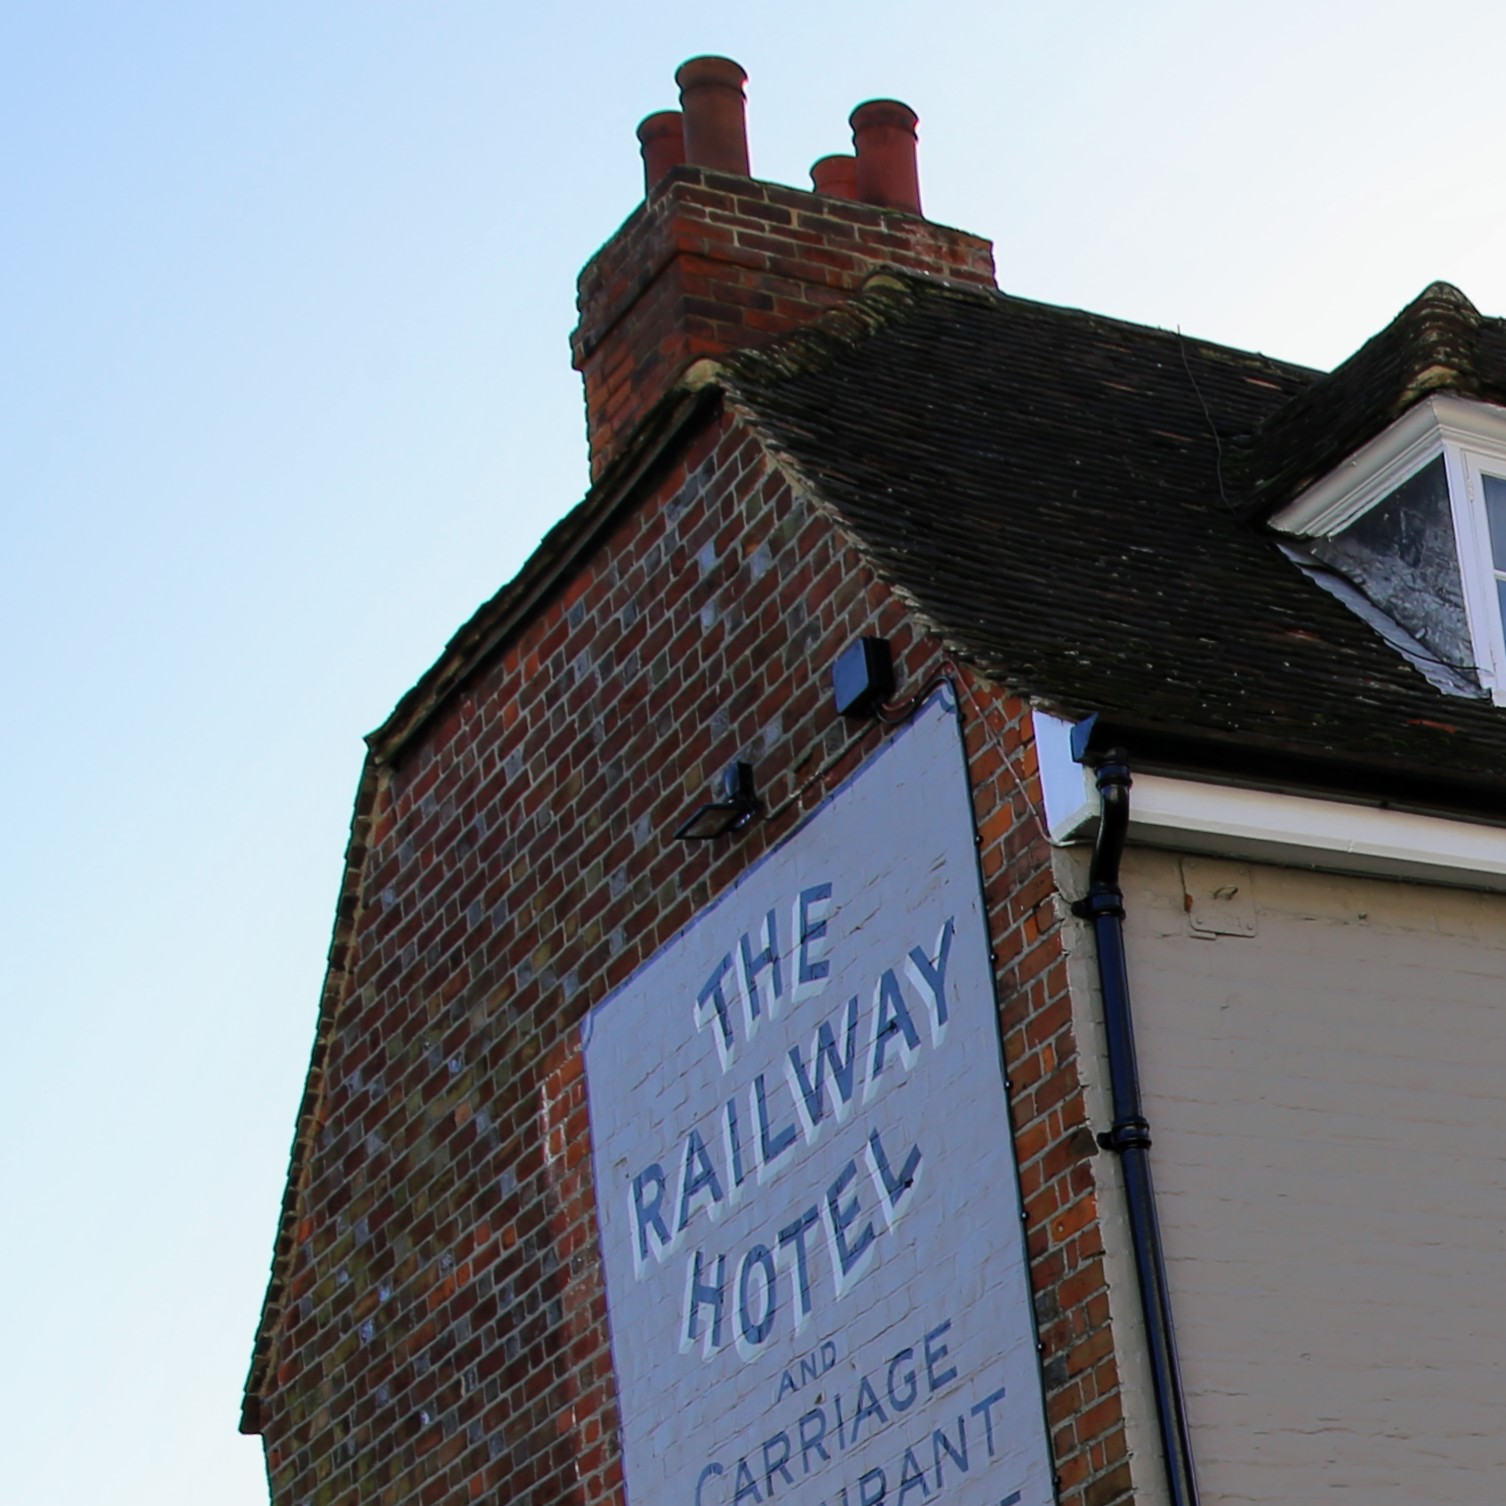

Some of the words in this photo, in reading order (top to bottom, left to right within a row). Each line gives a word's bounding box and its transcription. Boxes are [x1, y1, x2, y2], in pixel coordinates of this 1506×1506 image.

[694, 882, 833, 1073] THE
[628, 915, 956, 1282] RAILWAY
[679, 1127, 922, 1364] HOTEL
[777, 1340, 837, 1402] AND
